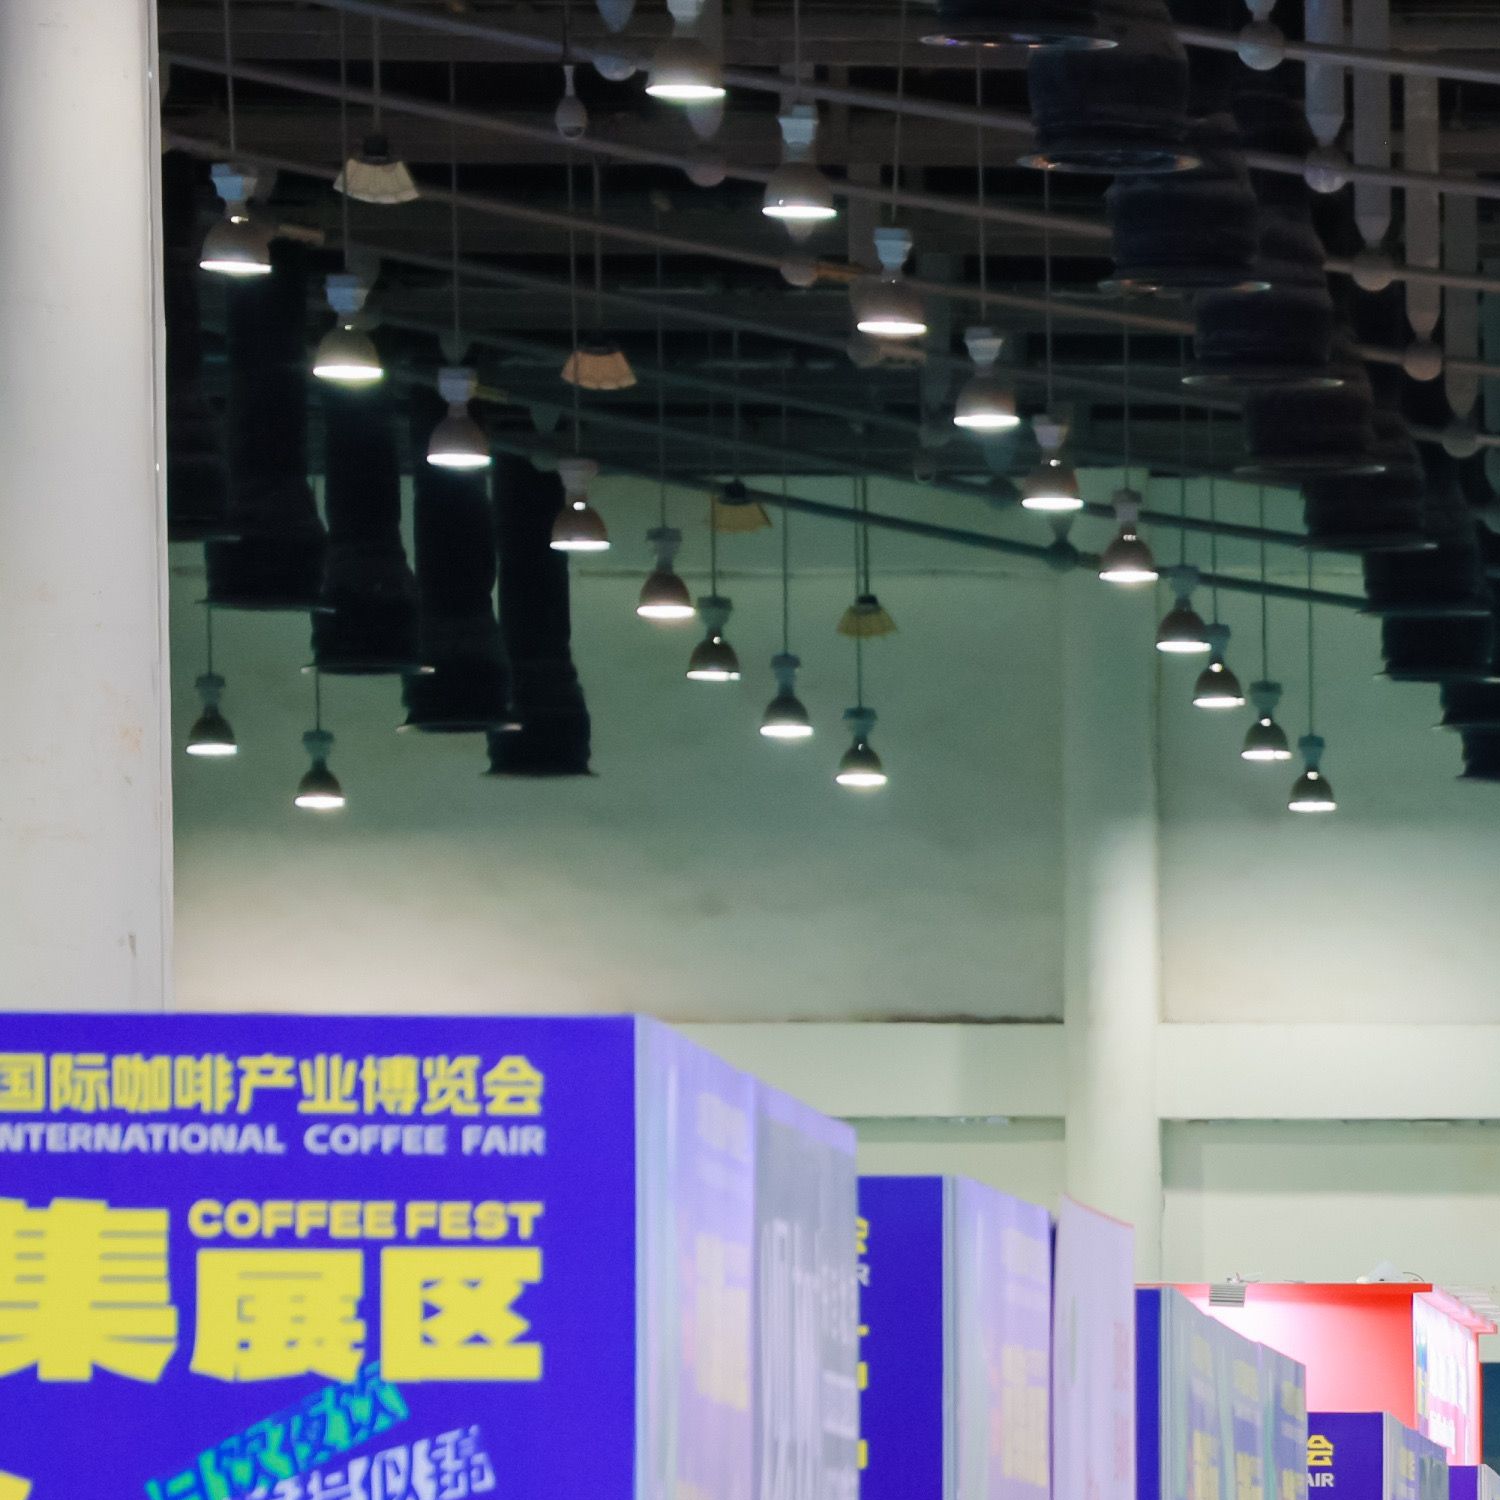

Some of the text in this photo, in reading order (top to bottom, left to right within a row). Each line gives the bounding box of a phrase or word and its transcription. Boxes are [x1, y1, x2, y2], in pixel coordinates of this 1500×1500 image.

[304, 1124, 447, 1155] COFFEE
[462, 1125, 546, 1155] FAIR
[188, 1199, 544, 1240] COFFEE FEST
